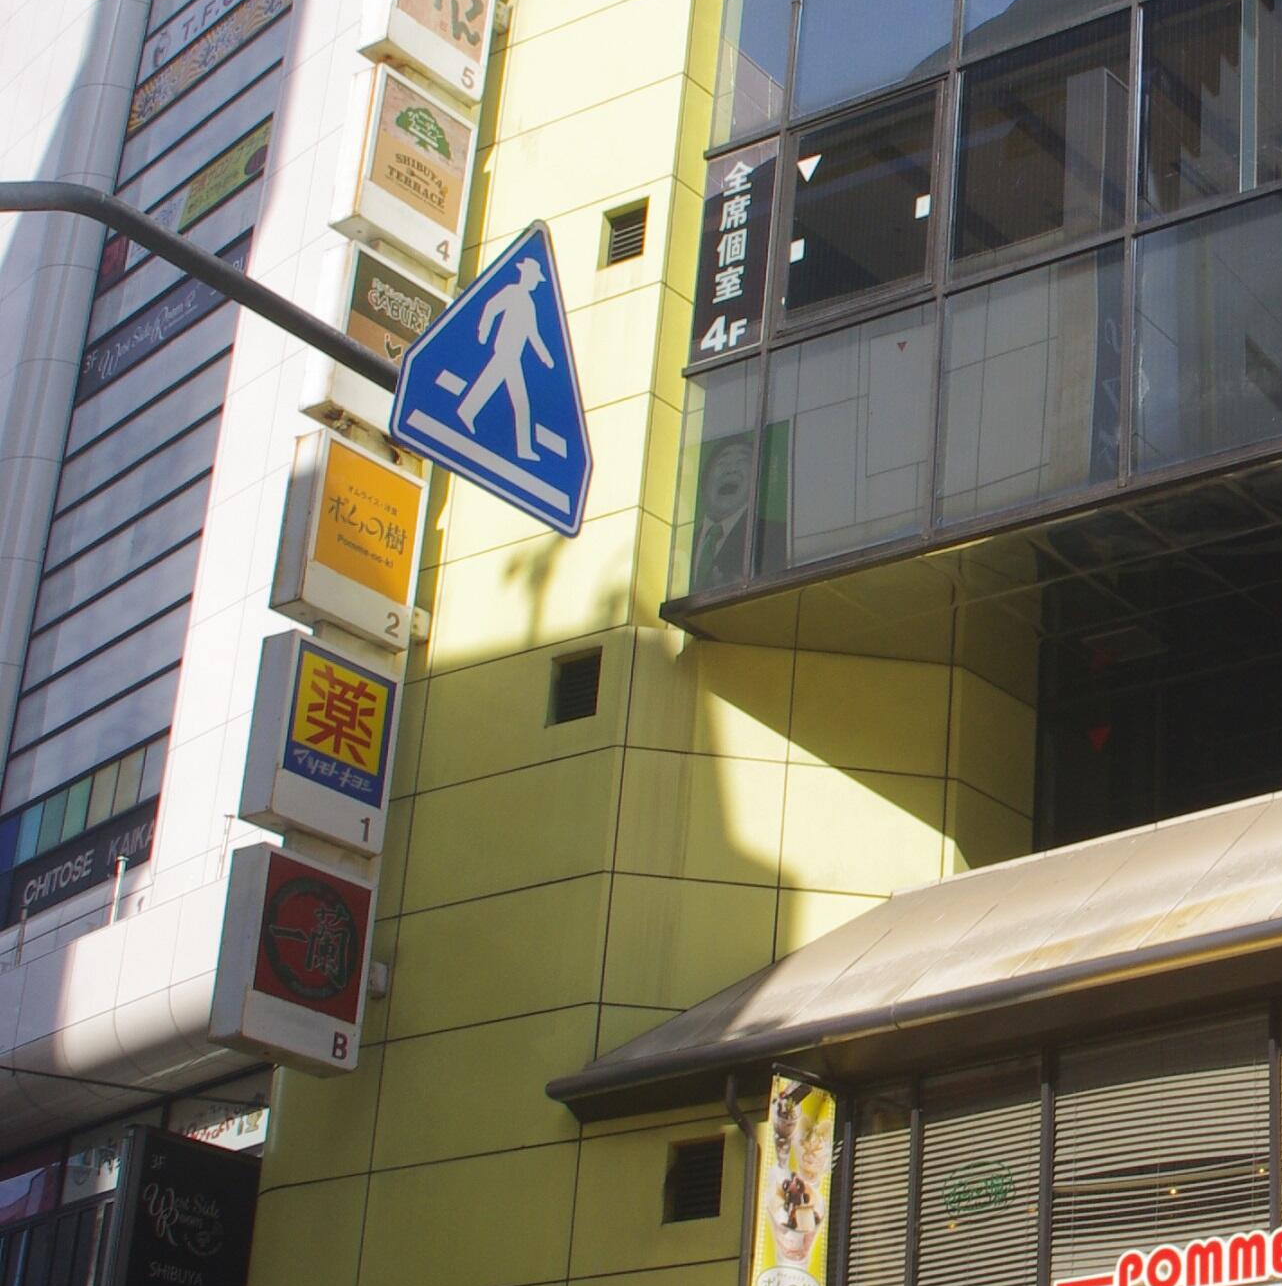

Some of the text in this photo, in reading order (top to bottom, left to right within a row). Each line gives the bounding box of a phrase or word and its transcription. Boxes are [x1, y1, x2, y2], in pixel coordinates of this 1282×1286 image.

[461, 67, 475, 91] 5
[386, 164, 446, 211] TERRACE
[395, 151, 444, 190] SHIBUYA
[436, 239, 450, 263] 4
[711, 161, 754, 305] 全席個室
[700, 315, 748, 353] 4F
[328, 494, 408, 557] ポムの樹
[384, 611, 401, 638] 2
[306, 664, 378, 768] 薬
[292, 746, 374, 796] マツモトキヨシ
[360, 816, 371, 844] 1
[23, 848, 94, 907] CHITOSE
[268, 904, 351, 988] 一蘭
[331, 1031, 349, 1061] B
[149, 1260, 203, 1286] SHIBUYA
